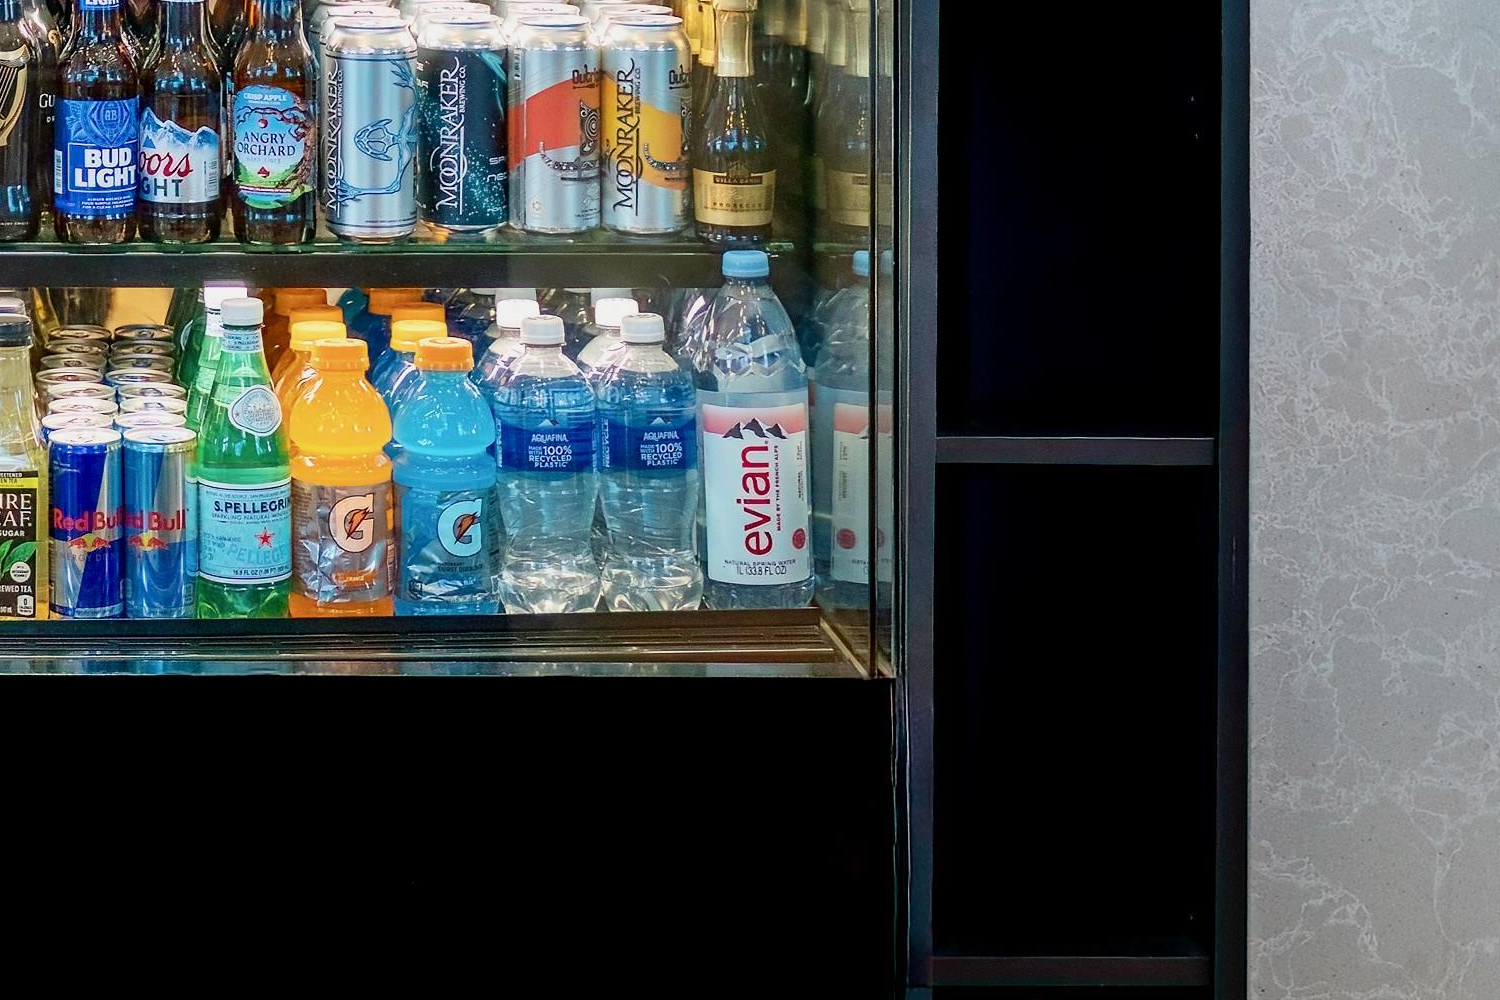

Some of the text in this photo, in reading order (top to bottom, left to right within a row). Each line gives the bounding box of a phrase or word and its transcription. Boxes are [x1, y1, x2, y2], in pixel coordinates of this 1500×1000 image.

[243, 92, 287, 102] CRISP APPLE
[243, 131, 286, 144] ANGRY
[324, 60, 340, 211] MOONRAKER
[435, 57, 460, 211] MOONRAKER
[614, 58, 640, 210] MOONRAKER
[237, 142, 296, 156] ORCHARD
[84, 149, 132, 168] BUD
[74, 167, 136, 188] LIGHT
[531, 434, 568, 443] AQUAFINA
[643, 431, 680, 441] AQUAFINA
[542, 445, 572, 455] 100%
[654, 442, 682, 453] 100%
[641, 452, 682, 460] RECYCLED
[736, 445, 772, 555] evian
[776, 504, 781, 512] BY
[52, 508, 88, 531] Red
[148, 509, 186, 530] Bull
[329, 493, 374, 553] G
[438, 499, 482, 557] G
[764, 567, 773, 575] FL
[21, 585, 32, 593] TEA
